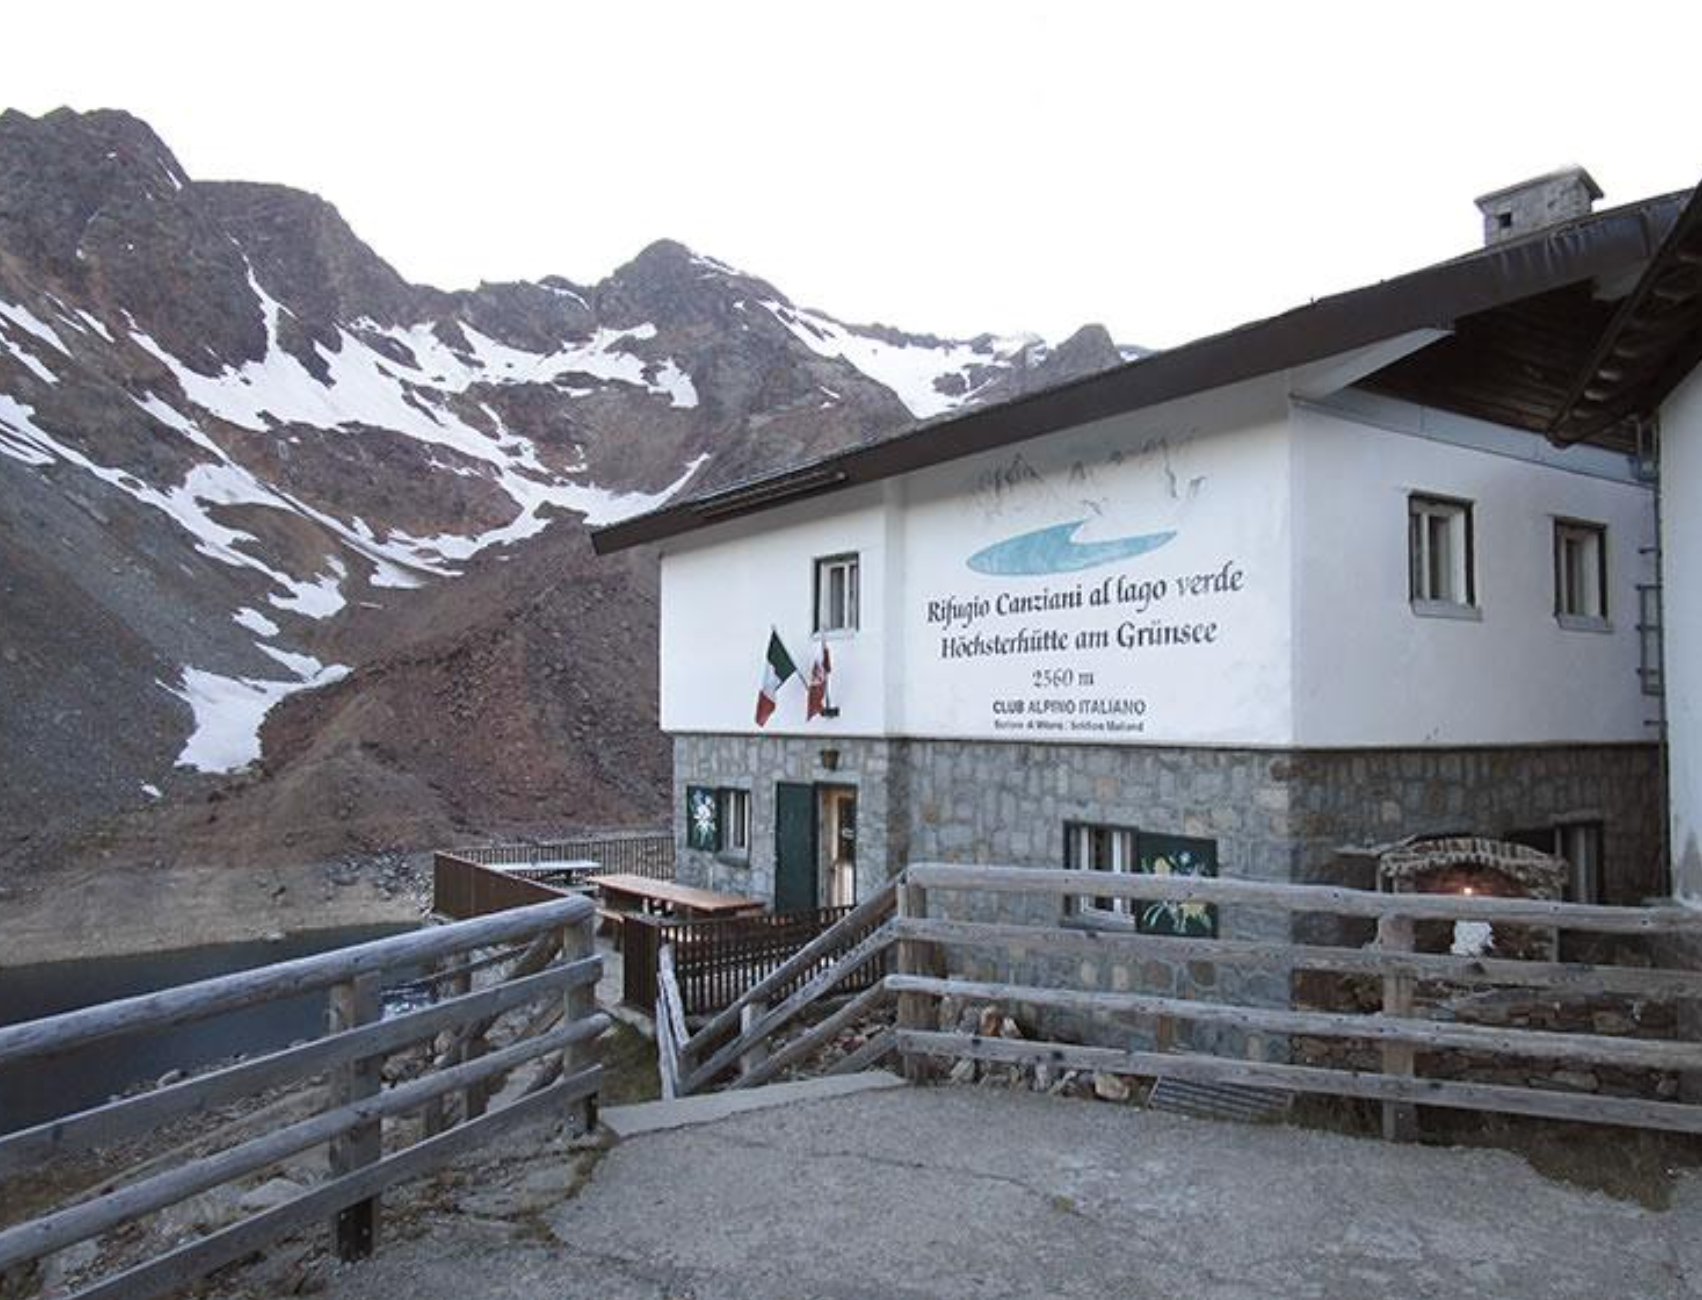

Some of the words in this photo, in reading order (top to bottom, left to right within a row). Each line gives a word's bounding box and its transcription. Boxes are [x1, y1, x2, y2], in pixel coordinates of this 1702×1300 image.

[927, 595, 990, 628] Rifugio
[997, 583, 1082, 617] Canziani
[1090, 577, 1110, 606] al
[1117, 574, 1167, 612] lago
[1176, 560, 1244, 597] verde
[941, 626, 1069, 659] Höchsterhütte
[1075, 629, 1109, 649] am
[1117, 619, 1218, 649] Grünsee
[1032, 668, 1074, 688] 2560
[1078, 672, 1094, 686] m
[992, 700, 1025, 714] CLUB
[1028, 700, 1076, 714] ALPINO
[1079, 699, 1147, 715] ITALIANO
